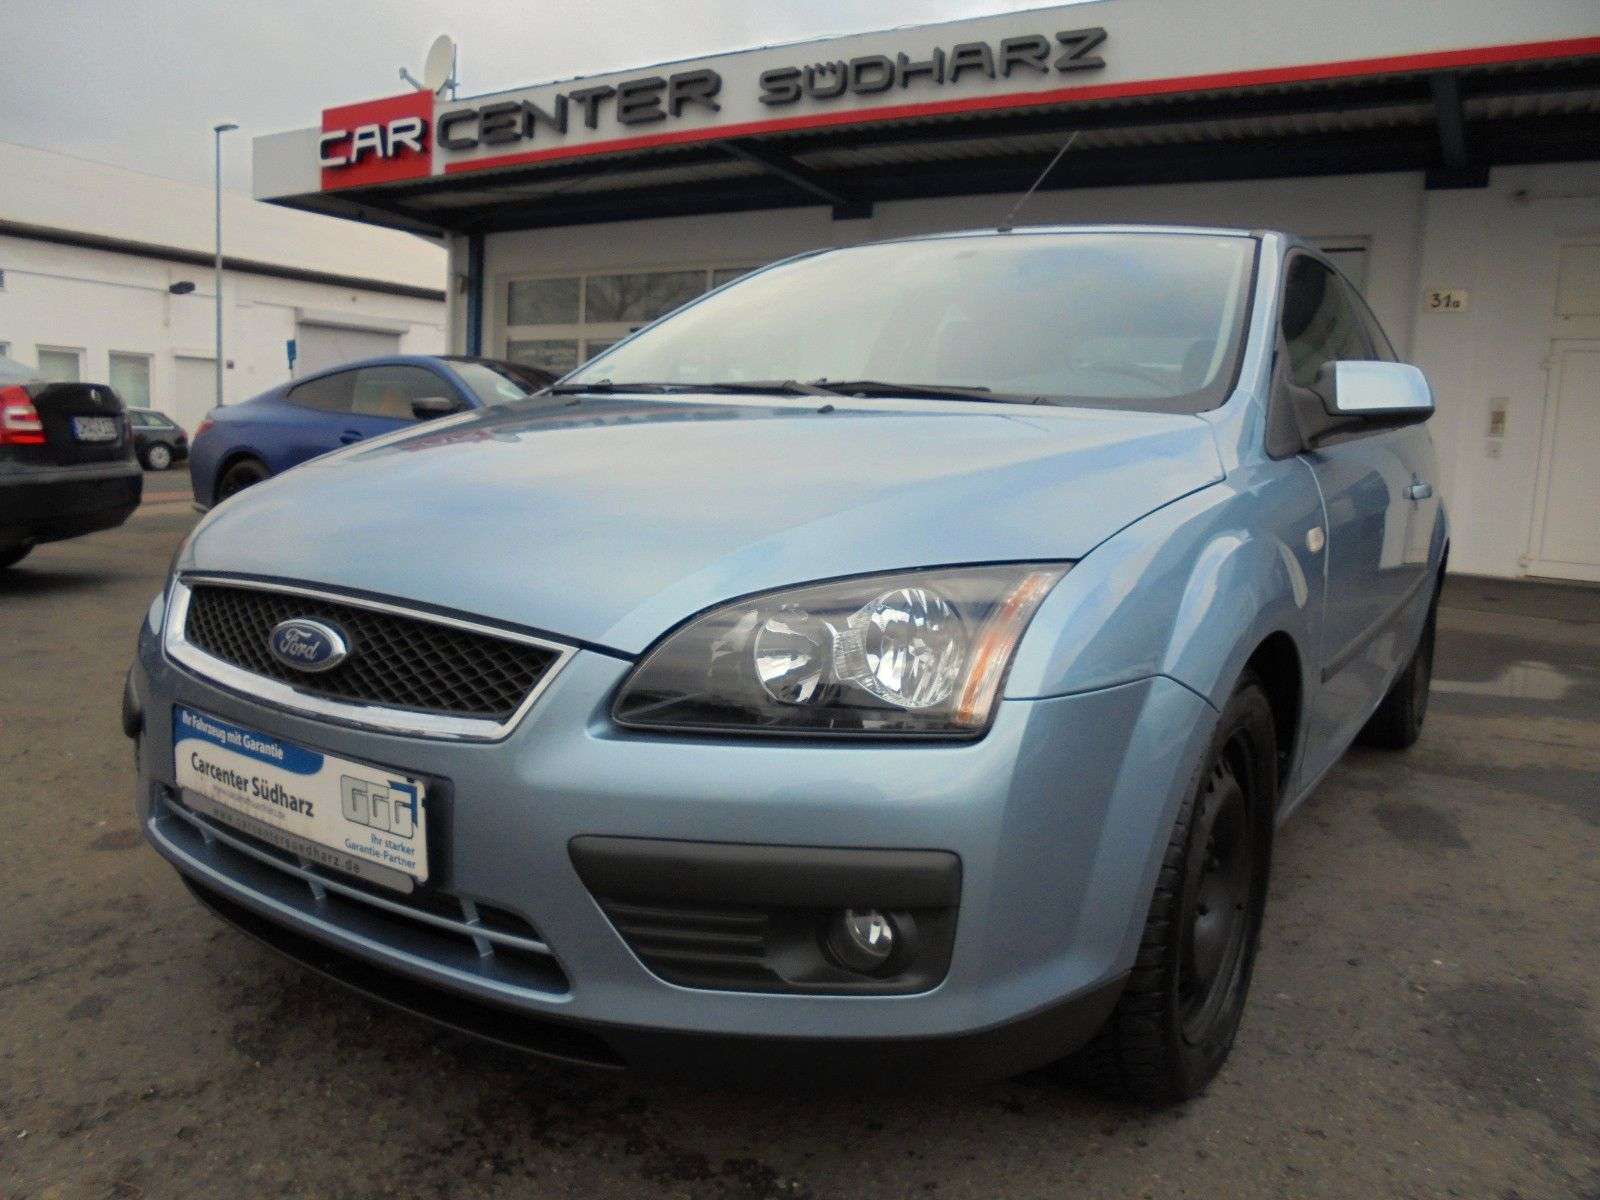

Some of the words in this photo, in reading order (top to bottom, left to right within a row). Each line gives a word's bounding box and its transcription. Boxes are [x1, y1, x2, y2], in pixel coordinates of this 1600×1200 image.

[319, 117, 425, 167] CAR
[437, 70, 722, 150] CENTER
[759, 27, 1108, 106] SÜDHARZ
[1430, 293, 1461, 308] 31a
[279, 627, 321, 660] Ford
[192, 714, 226, 743] Fahrzeug
[227, 730, 241, 746] mit
[243, 734, 284, 760] Garantie
[191, 751, 249, 792] Carcenter
[251, 775, 314, 818] Südharz
[344, 838, 416, 869] Garantie-Partner
[384, 840, 416, 855] starker
